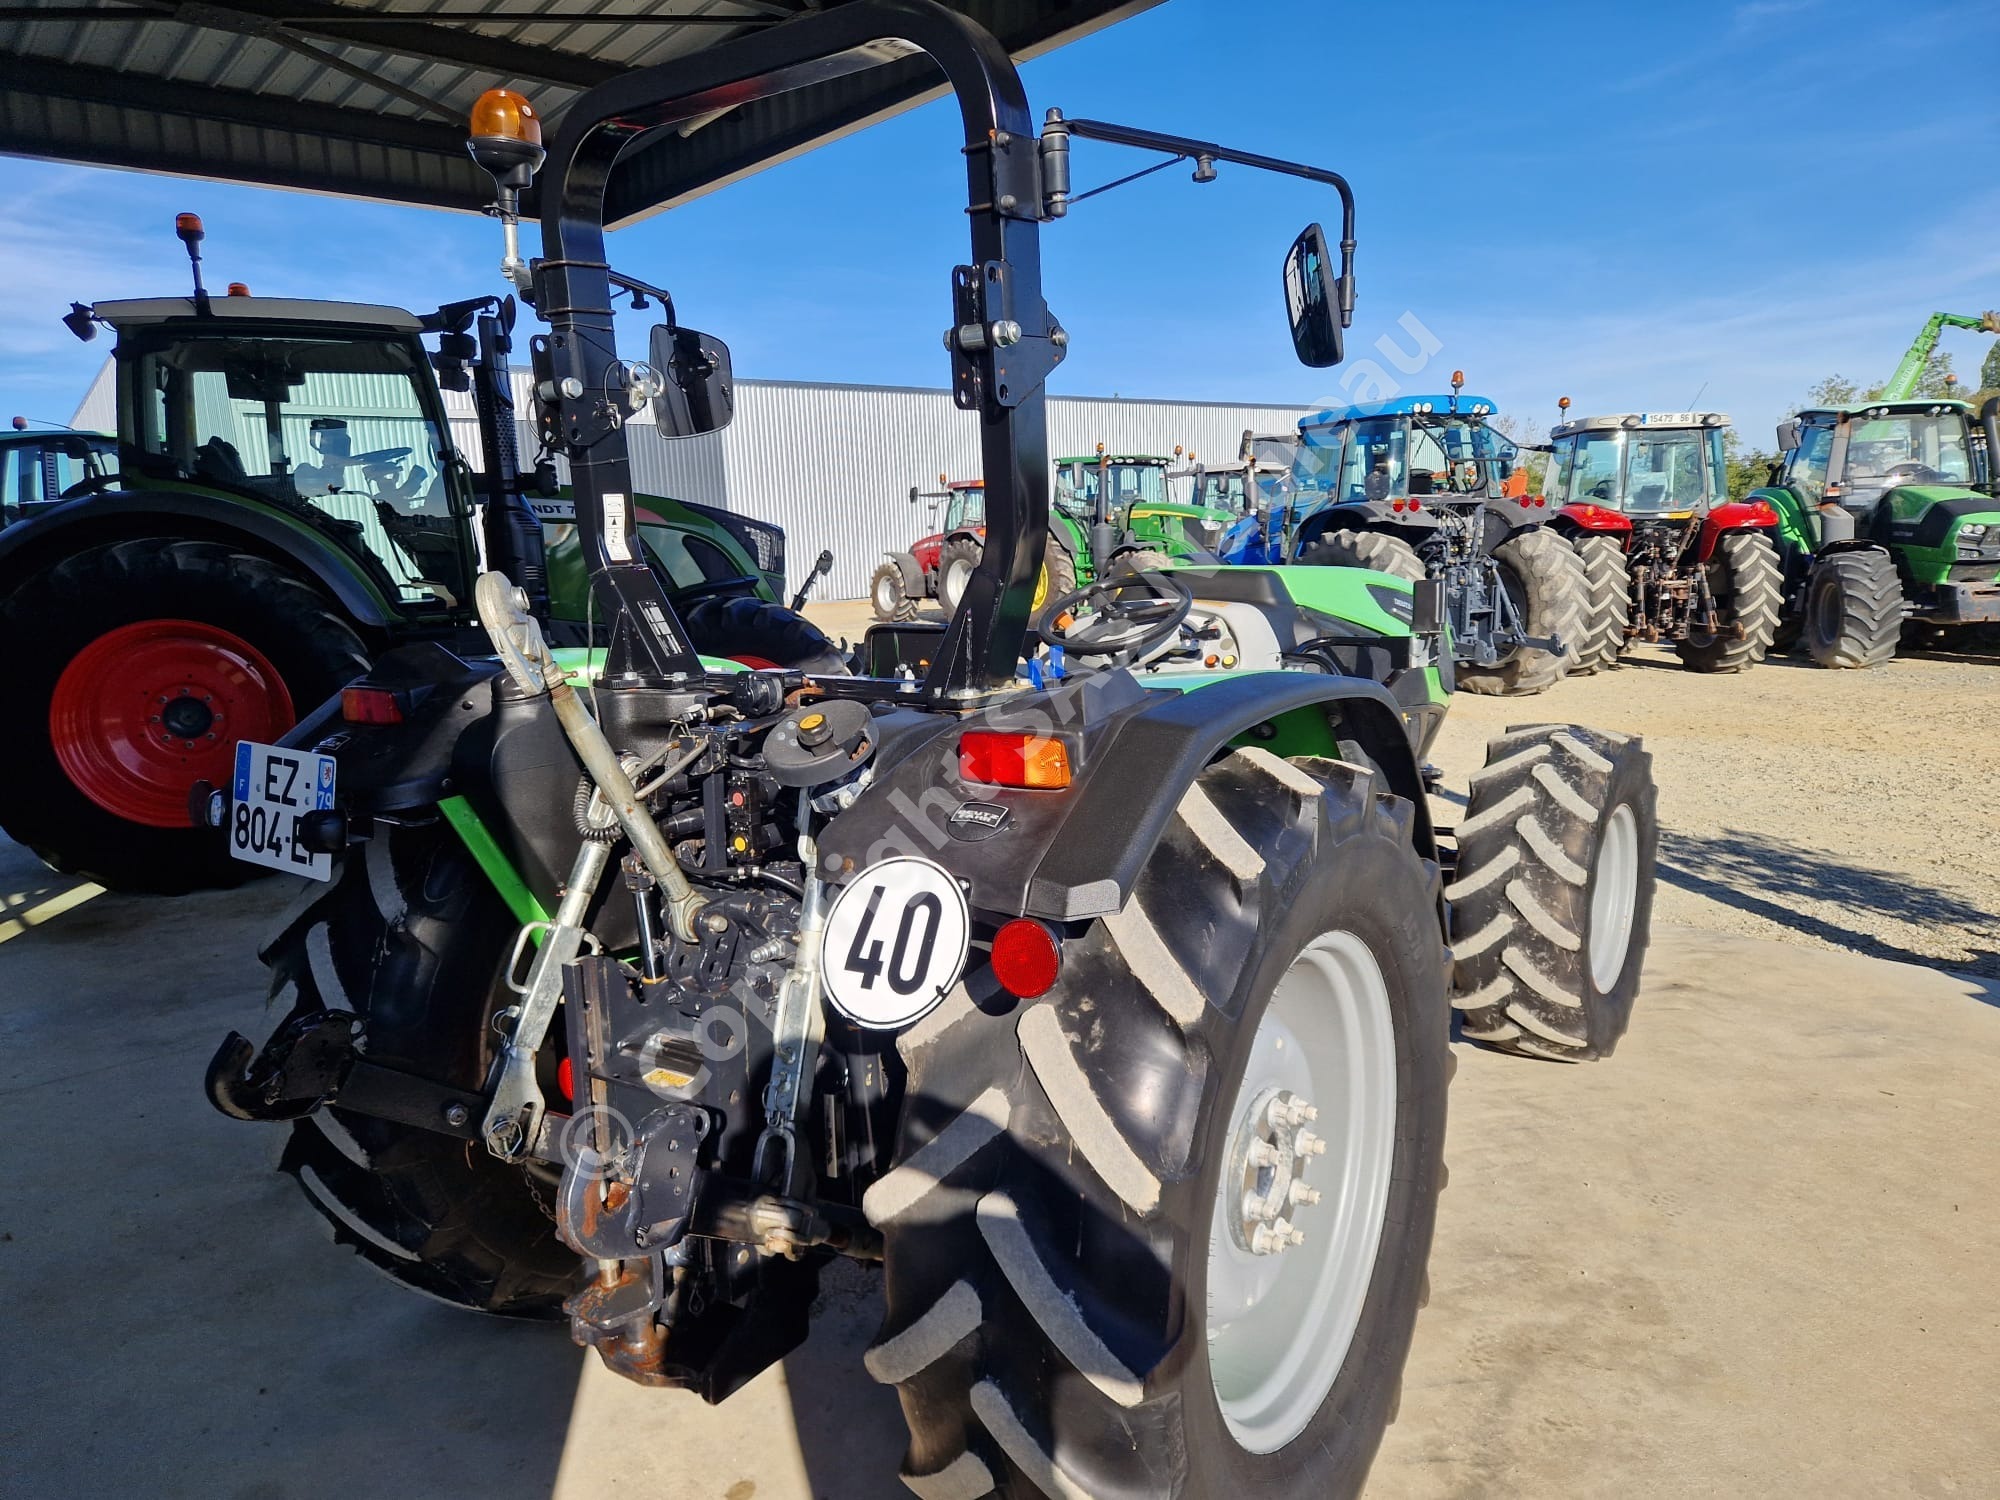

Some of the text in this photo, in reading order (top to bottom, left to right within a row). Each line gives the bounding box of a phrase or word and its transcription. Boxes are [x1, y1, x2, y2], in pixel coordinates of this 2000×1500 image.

[531, 504, 562, 514] NDT
[239, 779, 244, 791] F
[844, 885, 942, 996] 40
